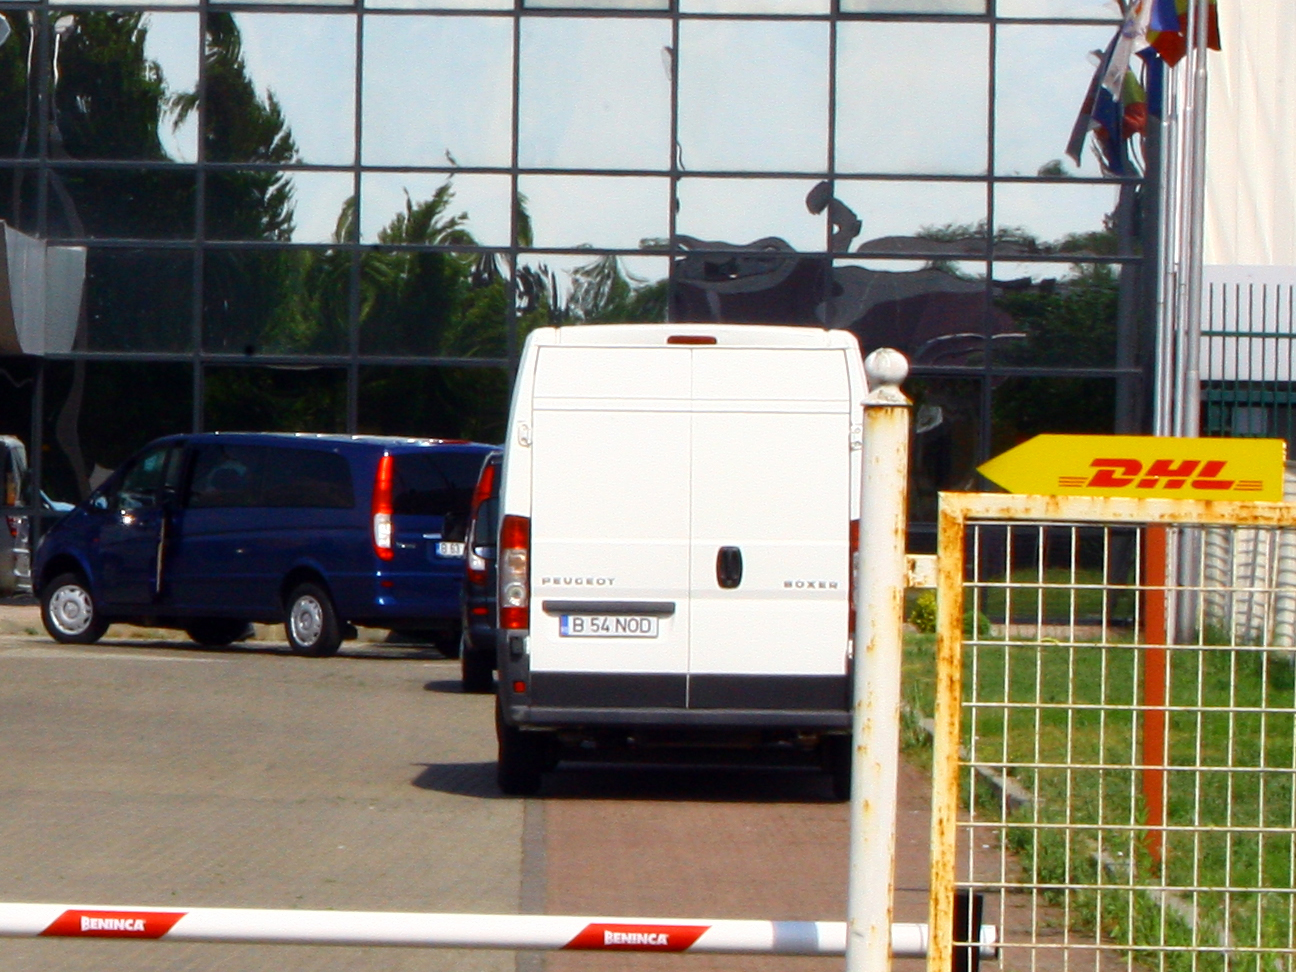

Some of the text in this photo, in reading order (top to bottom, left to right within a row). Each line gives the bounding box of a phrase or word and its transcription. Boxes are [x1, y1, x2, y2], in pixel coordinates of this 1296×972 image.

[1086, 458, 1236, 490] DHL
[541, 577, 616, 586] PEUGEOT
[783, 580, 839, 589] BOXER
[572, 617, 652, 634] B 54 NOD
